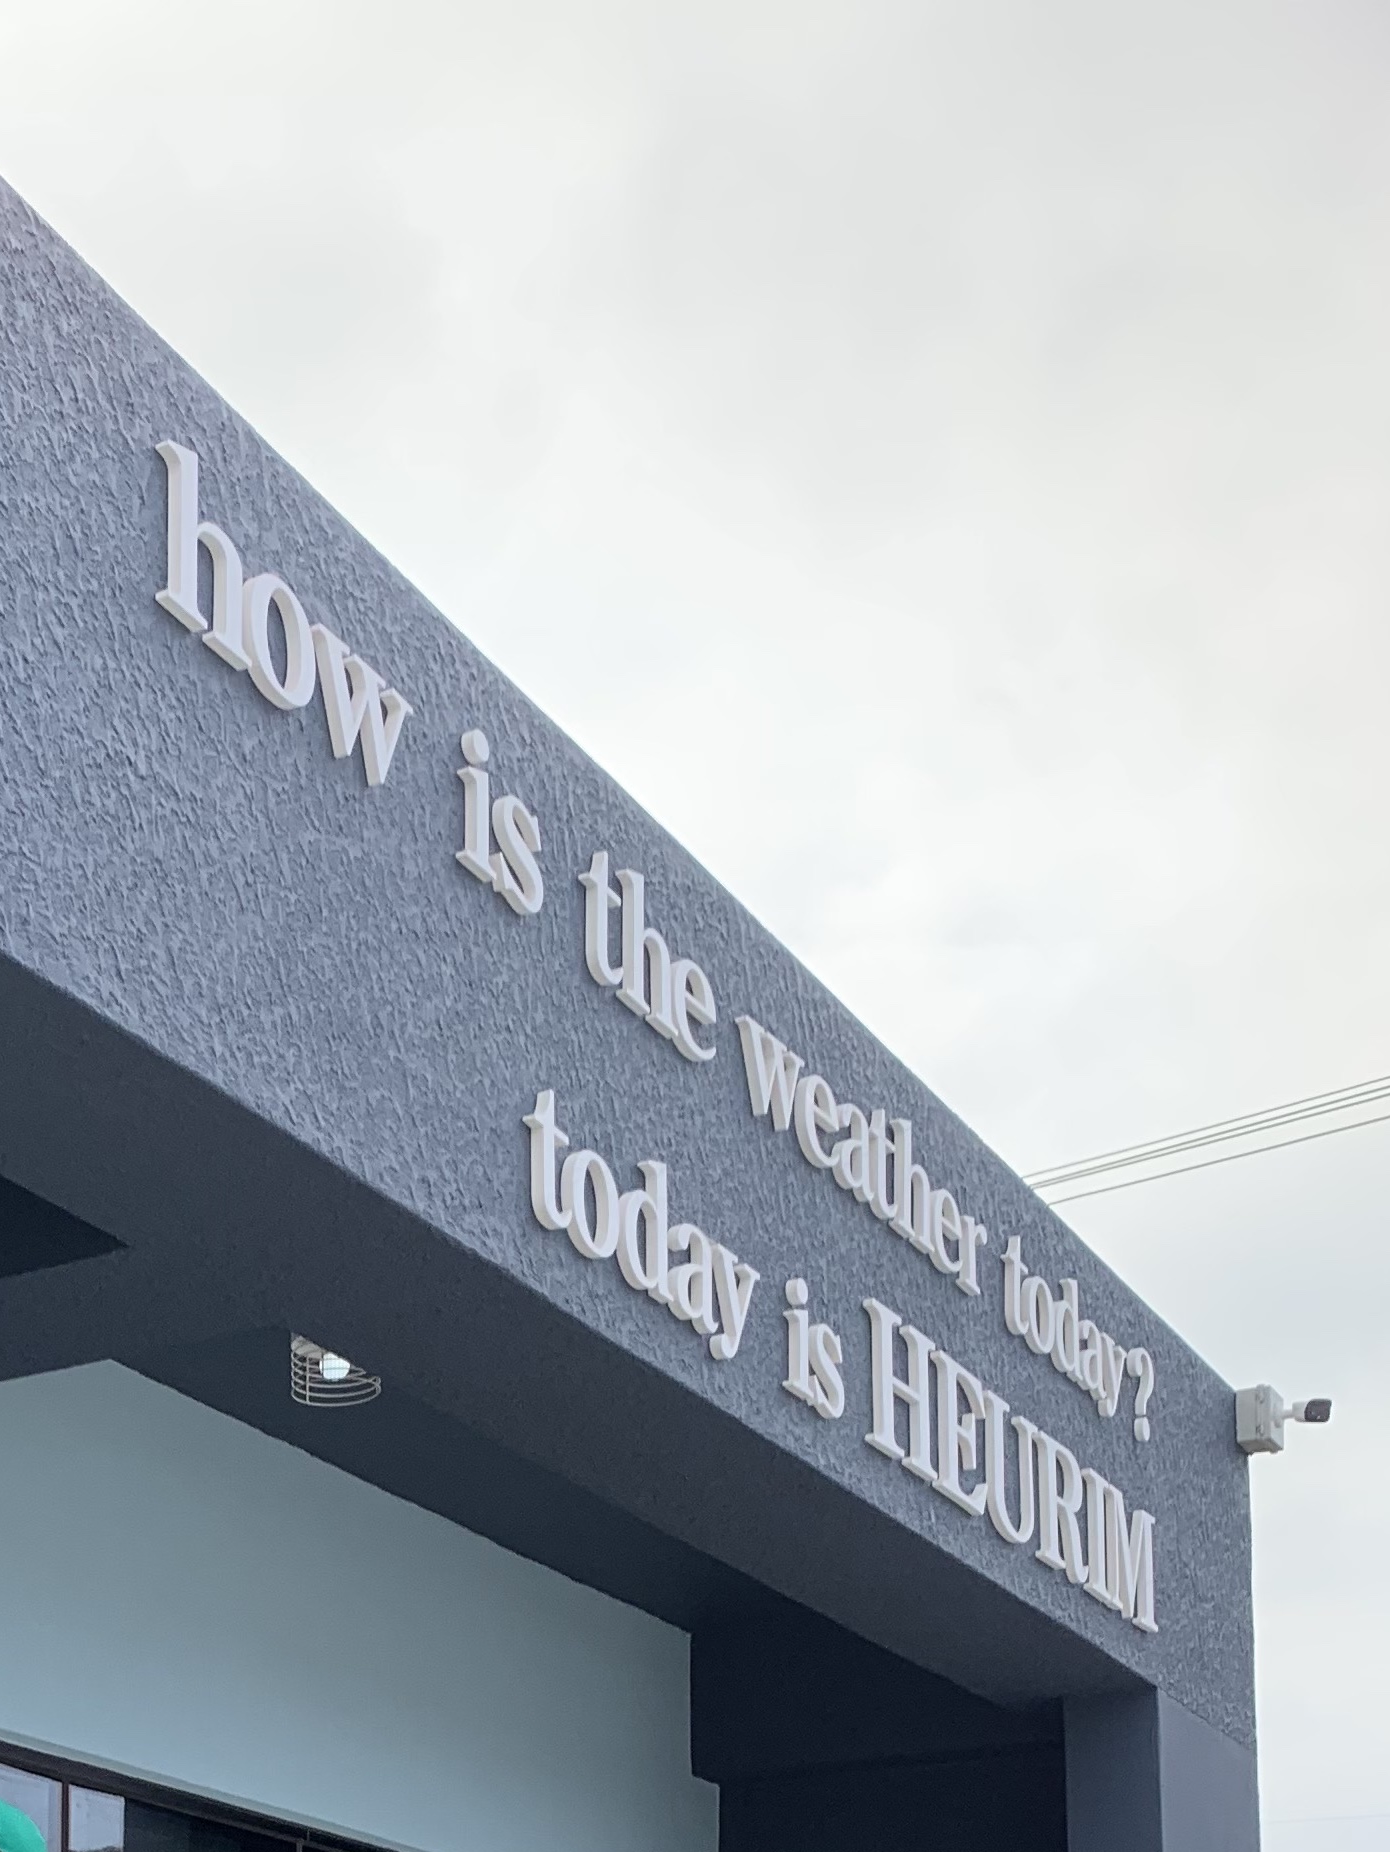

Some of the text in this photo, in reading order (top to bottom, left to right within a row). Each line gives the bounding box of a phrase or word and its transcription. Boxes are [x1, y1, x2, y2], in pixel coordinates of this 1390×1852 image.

[155, 440, 1155, 1442] how is the weather today?
[523, 1089, 1158, 1634] today is HEURIM
